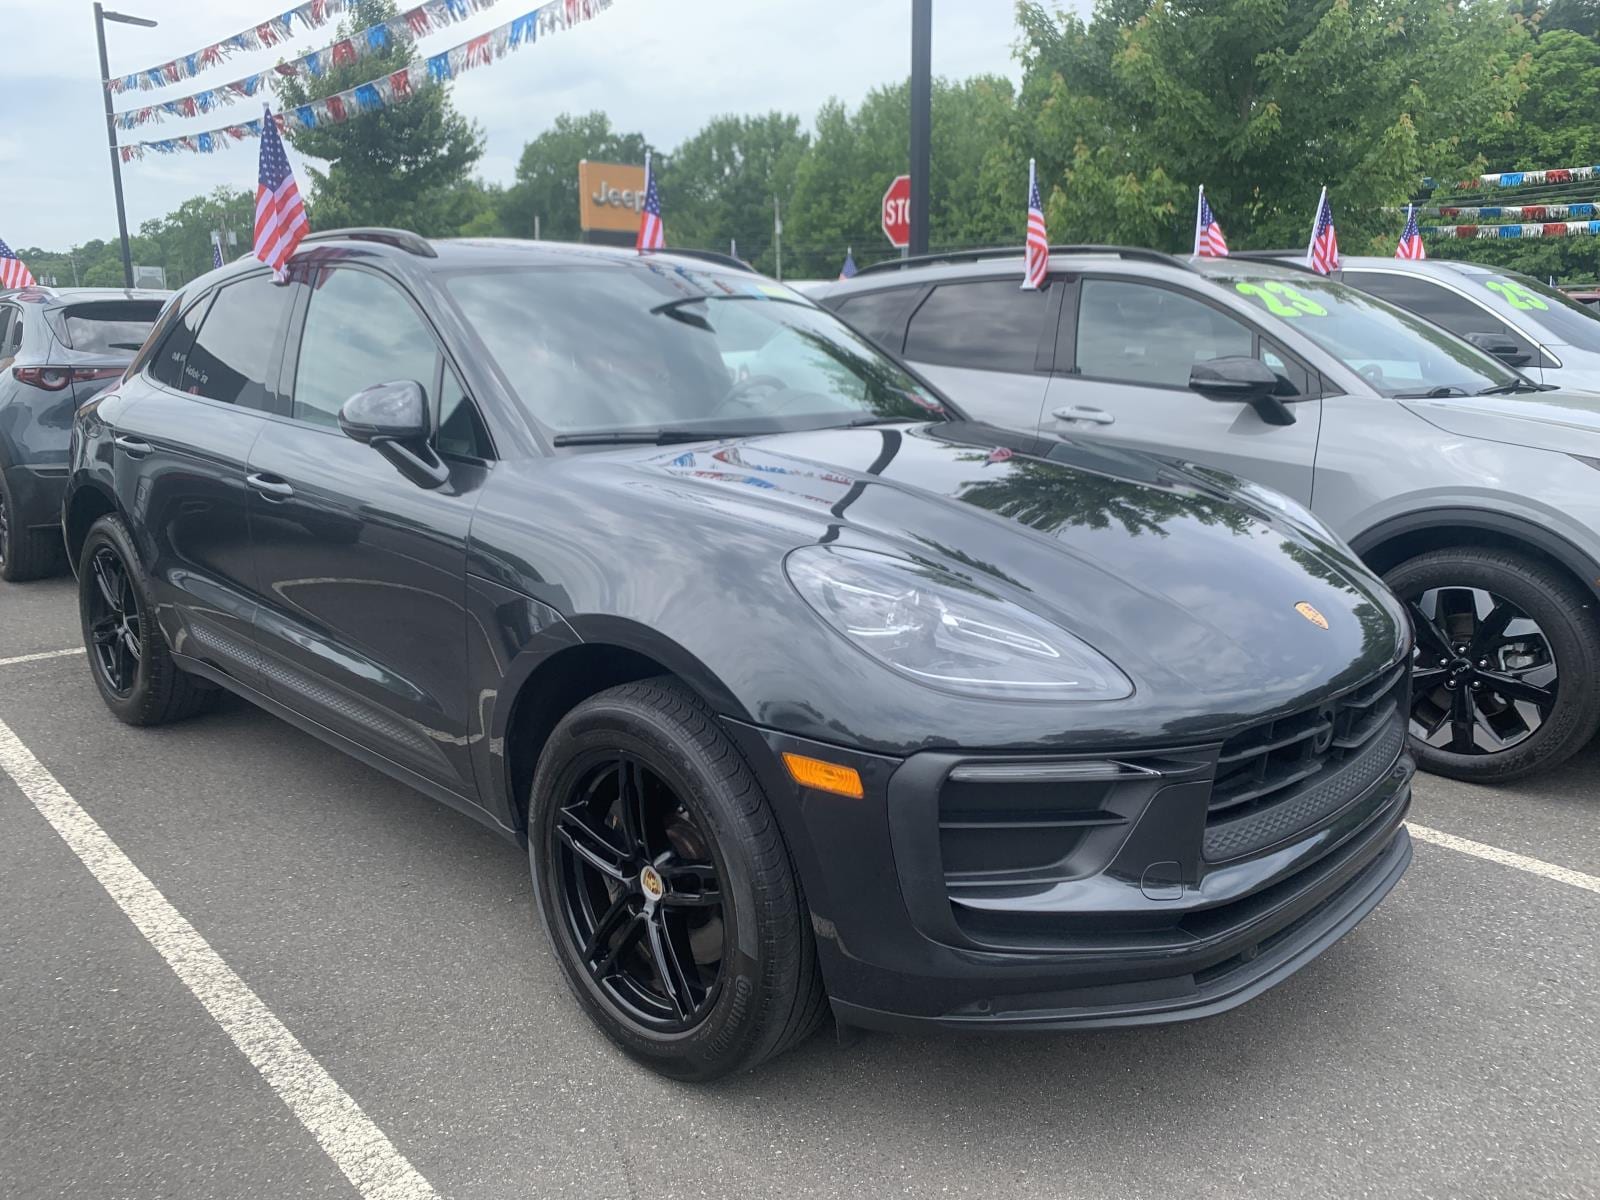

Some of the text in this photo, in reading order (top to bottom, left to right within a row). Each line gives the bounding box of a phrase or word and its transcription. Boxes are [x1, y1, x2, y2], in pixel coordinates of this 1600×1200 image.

[592, 180, 646, 213] Jeep
[1236, 280, 1328, 317] 23
[1486, 281, 1549, 310] 25
